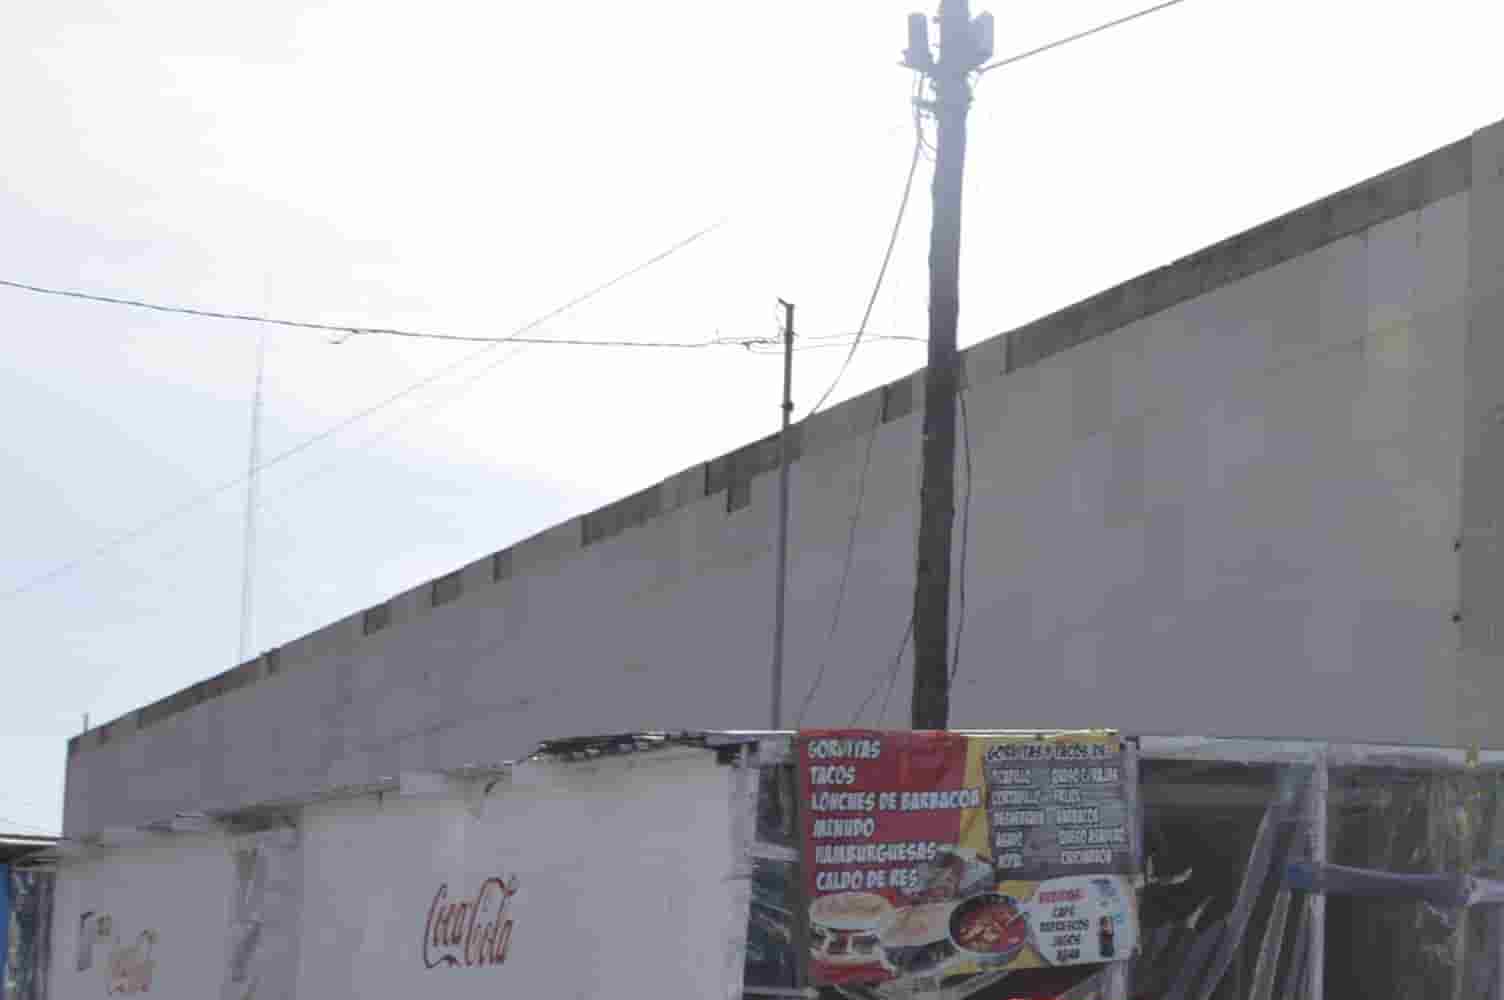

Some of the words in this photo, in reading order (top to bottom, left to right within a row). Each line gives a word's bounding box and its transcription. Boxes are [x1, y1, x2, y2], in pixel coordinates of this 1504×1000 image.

[810, 765, 857, 785] TACOS
[810, 790, 876, 812] LONCHES
[879, 791, 898, 811] DE
[815, 841, 937, 865] HAMBURGUESAS
[815, 869, 864, 891] CALDO
[865, 869, 886, 889] DE
[889, 868, 919, 889] RES
